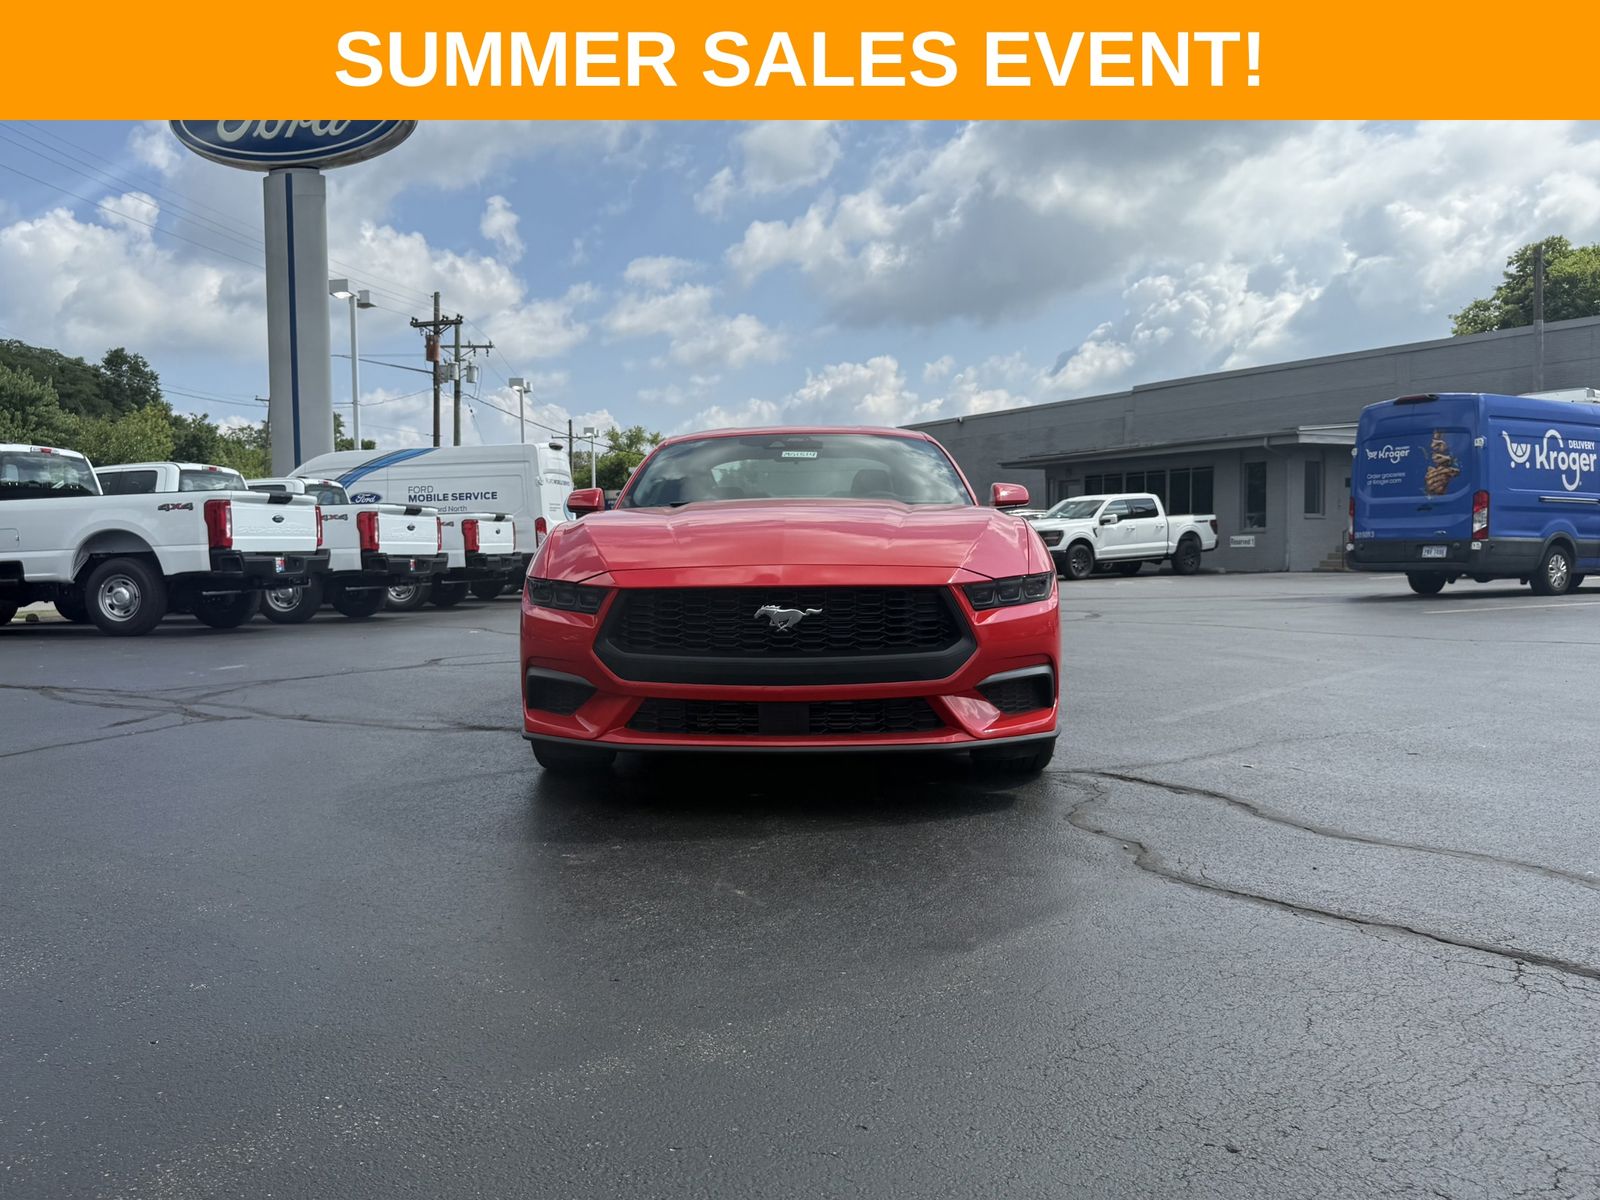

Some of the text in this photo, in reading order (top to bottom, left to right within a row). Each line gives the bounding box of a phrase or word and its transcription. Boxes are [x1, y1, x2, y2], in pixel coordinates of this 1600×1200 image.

[1568, 440, 1595, 450] DELIVERY
[1378, 444, 1410, 464] Kroger
[1535, 429, 1597, 491] Kroger
[408, 486, 434, 494] FORD
[355, 494, 376, 504] Ford
[408, 491, 498, 503] MOBILE SERVICE
